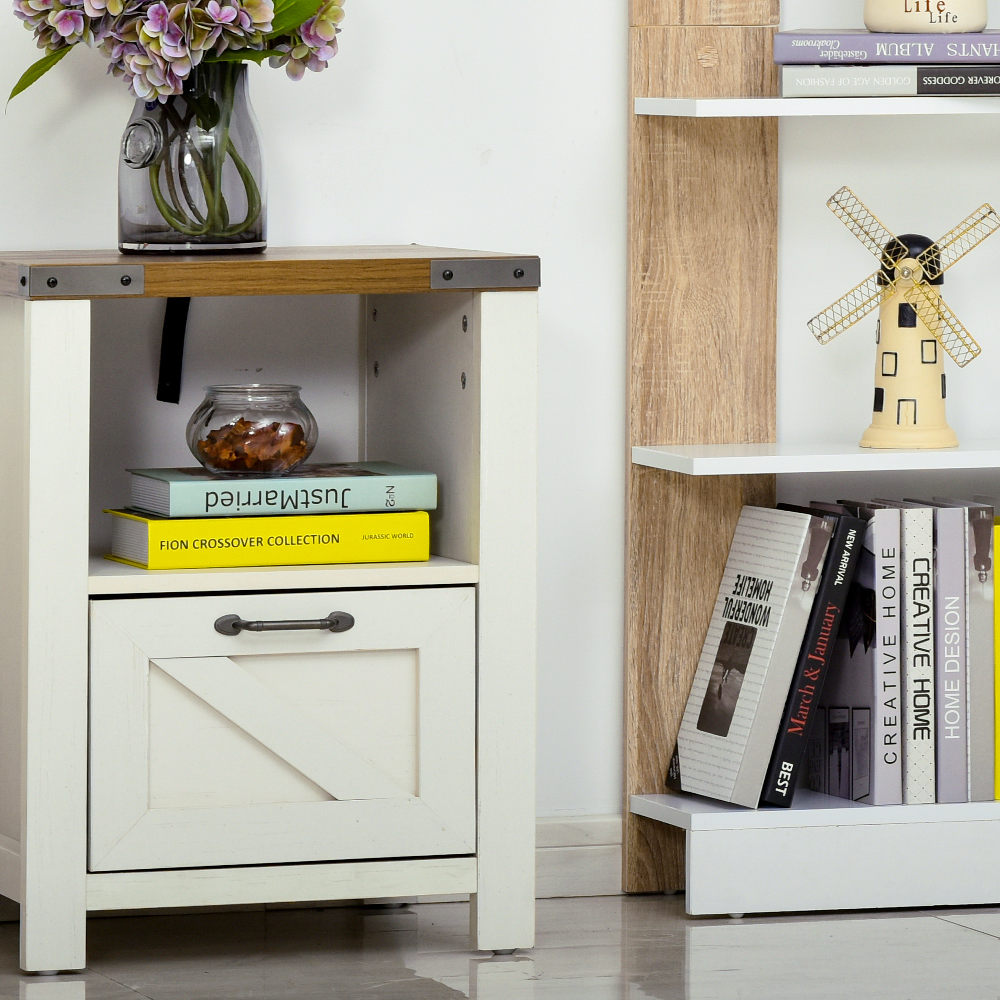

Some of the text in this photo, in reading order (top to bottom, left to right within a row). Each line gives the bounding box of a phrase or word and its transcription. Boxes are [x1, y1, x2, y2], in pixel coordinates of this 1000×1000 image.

[929, 11, 958, 23] Life
[792, 40, 840, 49] Cloakrooms
[876, 43, 934, 56] ALBUM
[796, 77, 911, 86] GOLDEN AGE OF FASHION
[923, 76, 965, 85] GODDESS
[205, 488, 351, 512] JustMarried
[160, 534, 340, 551] FION CROSSOVER COLLECTION
[834, 529, 857, 586] NEW ARRIVAL
[732, 574, 773, 602] HOMELIFE
[722, 597, 771, 627] WONDERFUL
[882, 547, 898, 765] CREATIVE HOME
[912, 557, 931, 740] CREATIVE HOME
[788, 602, 841, 736] March & January
[944, 596, 960, 739] HOME DESIGN
[775, 762, 794, 797] BEST
